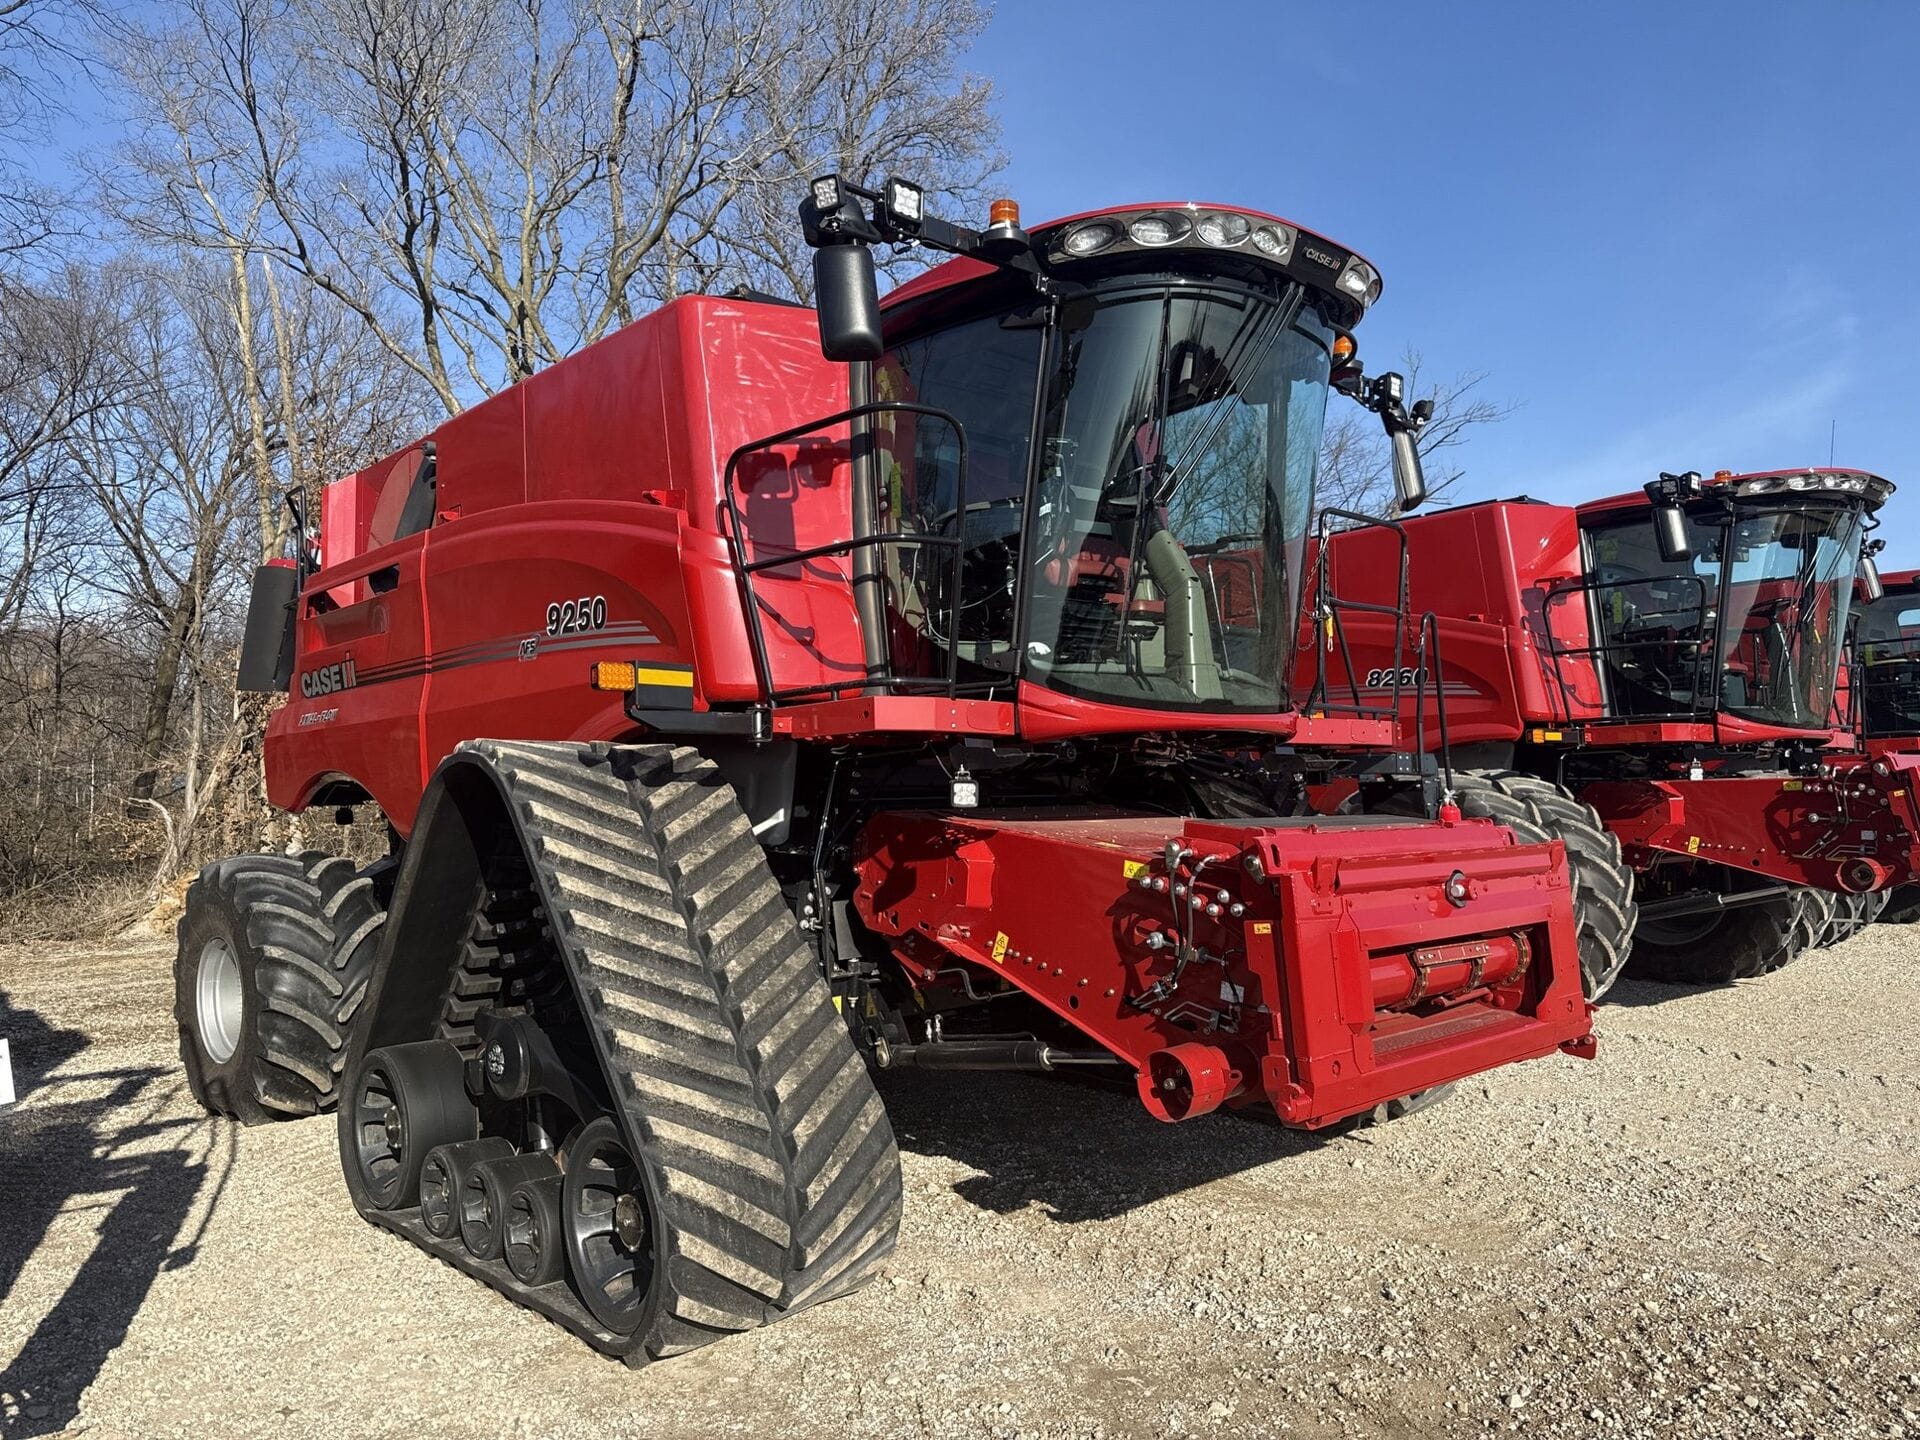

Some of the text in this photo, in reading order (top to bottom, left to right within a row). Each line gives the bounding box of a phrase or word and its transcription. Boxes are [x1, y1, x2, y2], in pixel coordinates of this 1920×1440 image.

[1306, 248, 1331, 267] CASE
[546, 595, 607, 636] 9250
[301, 664, 342, 698] CASE
[1366, 667, 1430, 688] 8260
